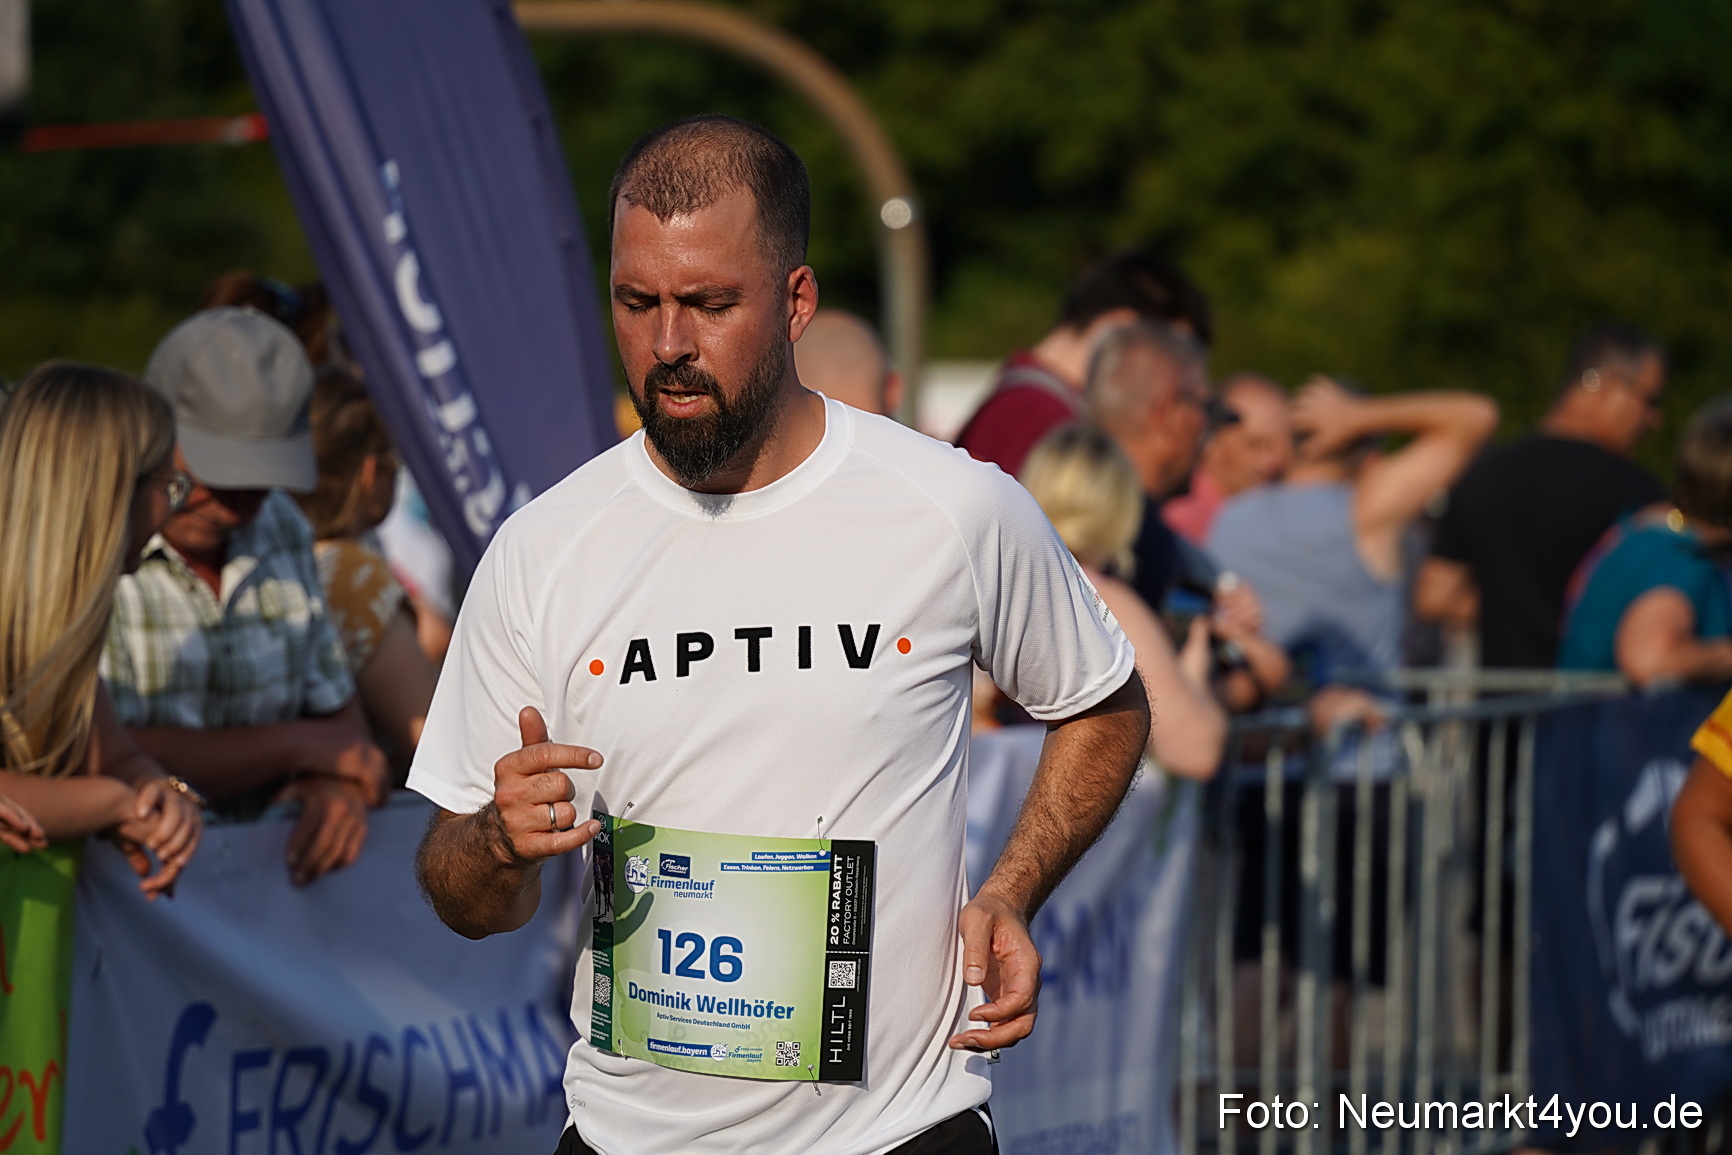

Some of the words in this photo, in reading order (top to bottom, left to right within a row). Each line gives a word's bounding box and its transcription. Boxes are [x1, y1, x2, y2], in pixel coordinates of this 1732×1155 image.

[619, 623, 882, 685] APTIV
[651, 876, 716, 891] Firmenlauf
[674, 891, 713, 899] neumarkt
[832, 854, 843, 910] RABATT
[845, 856, 854, 897] OUTLET
[830, 926, 840, 945] 20
[831, 912, 840, 923] %
[843, 898, 852, 945] FACTORY
[657, 928, 743, 982] 126
[629, 982, 691, 1011] Dominik
[696, 994, 795, 1020] Wellhöfer
[657, 1012, 670, 1021] Aptiv
[670, 1015, 692, 1024] Services
[692, 1018, 730, 1028] Deutschland
[731, 1022, 751, 1030] GmbH
[829, 996, 846, 1063] HILTL
[649, 1041, 708, 1056] firmenlauf.bayern
